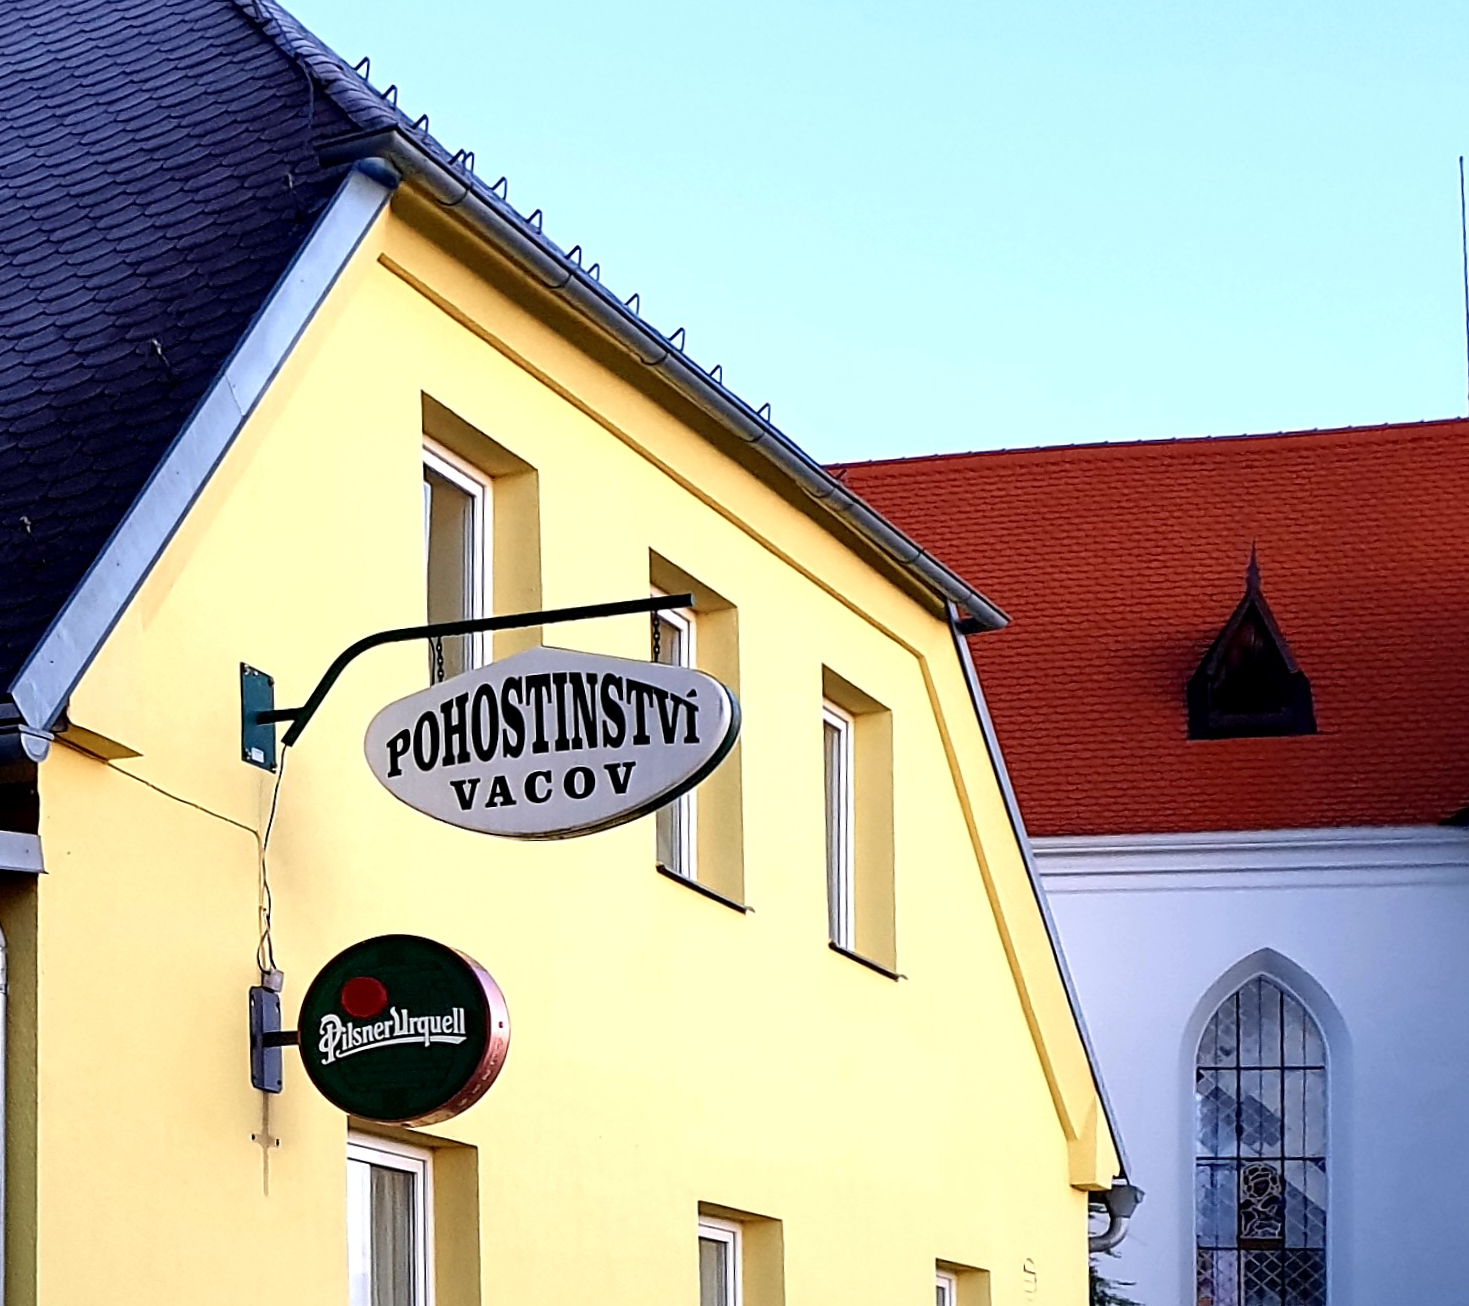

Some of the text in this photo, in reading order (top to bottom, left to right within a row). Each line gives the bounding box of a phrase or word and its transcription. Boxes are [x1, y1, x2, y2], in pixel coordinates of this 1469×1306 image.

[385, 670, 700, 778] POHOSTINSTVÍ
[449, 761, 636, 811] VACOV
[318, 1006, 467, 1065] Pilsner Urquell
